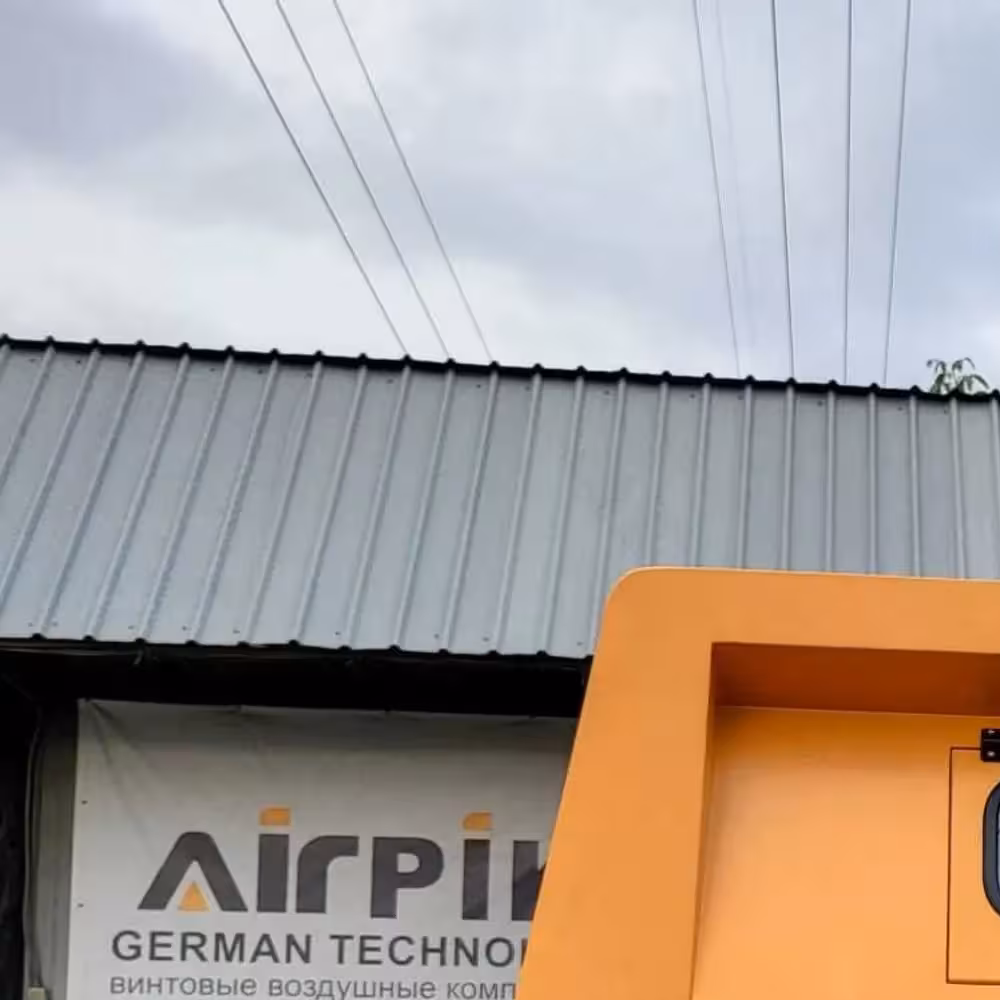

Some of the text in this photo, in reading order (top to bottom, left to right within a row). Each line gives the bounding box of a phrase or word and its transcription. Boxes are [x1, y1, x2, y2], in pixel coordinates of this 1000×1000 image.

[111, 930, 529, 969] GERMAN TECHNO
[109, 976, 258, 997] винтовые
